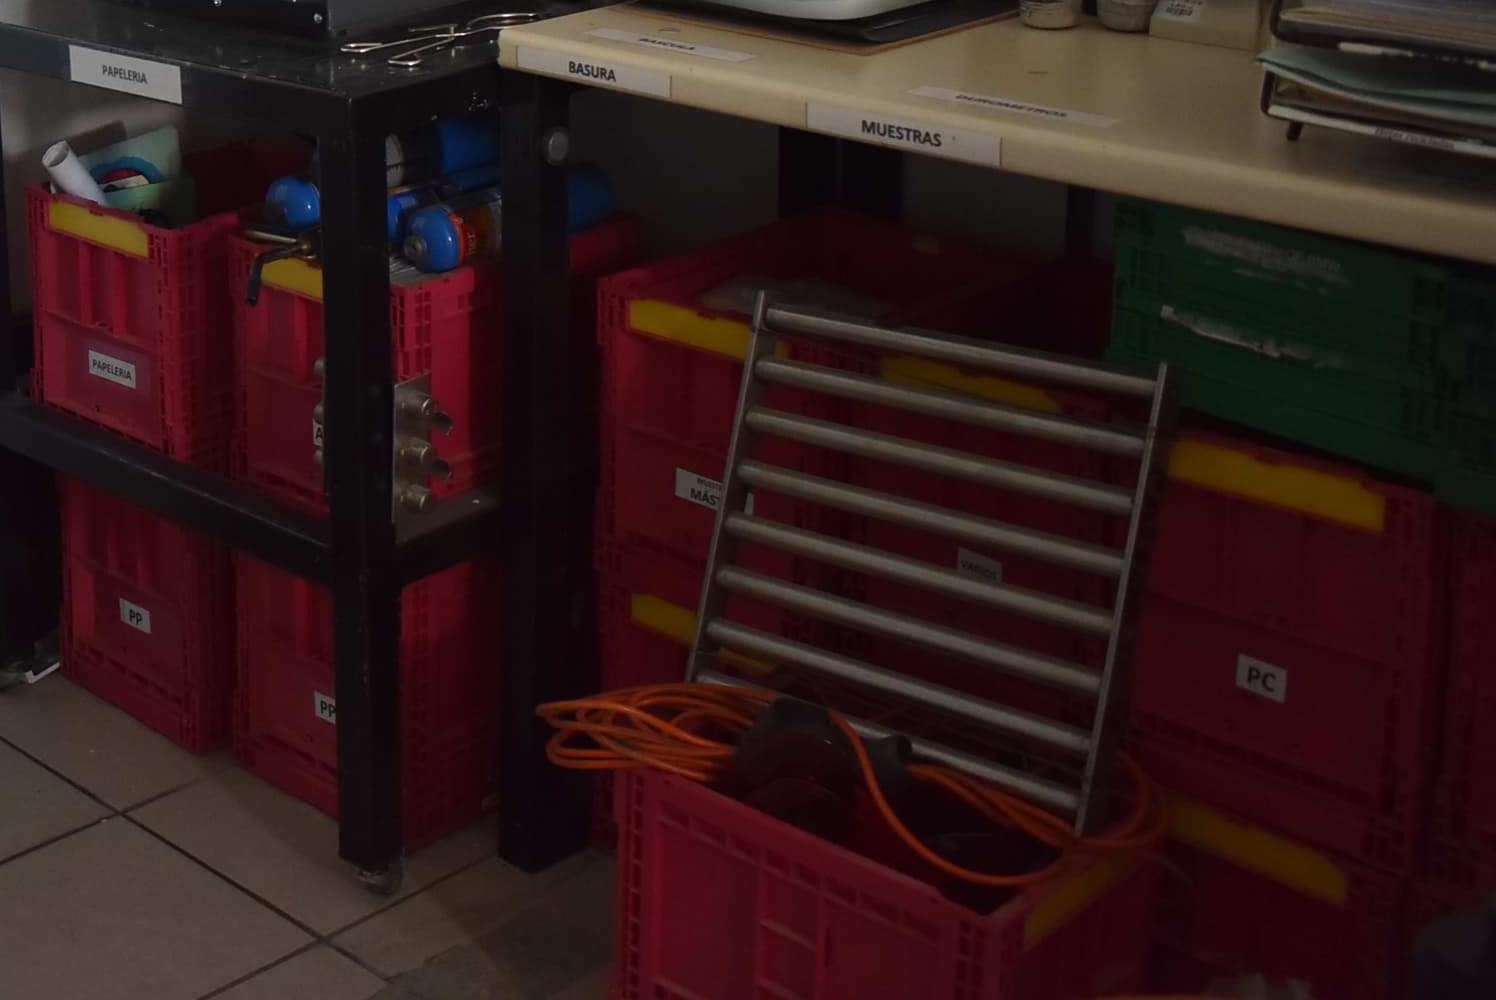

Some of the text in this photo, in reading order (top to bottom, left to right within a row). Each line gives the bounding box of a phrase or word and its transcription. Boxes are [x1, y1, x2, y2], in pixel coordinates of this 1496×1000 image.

[102, 64, 148, 85] PAPELERIA
[568, 60, 617, 83] BASURA
[861, 119, 943, 148] MUESTRAS
[92, 358, 132, 381] PAPELERIA
[129, 608, 143, 625] PP
[1247, 665, 1276, 693] PC
